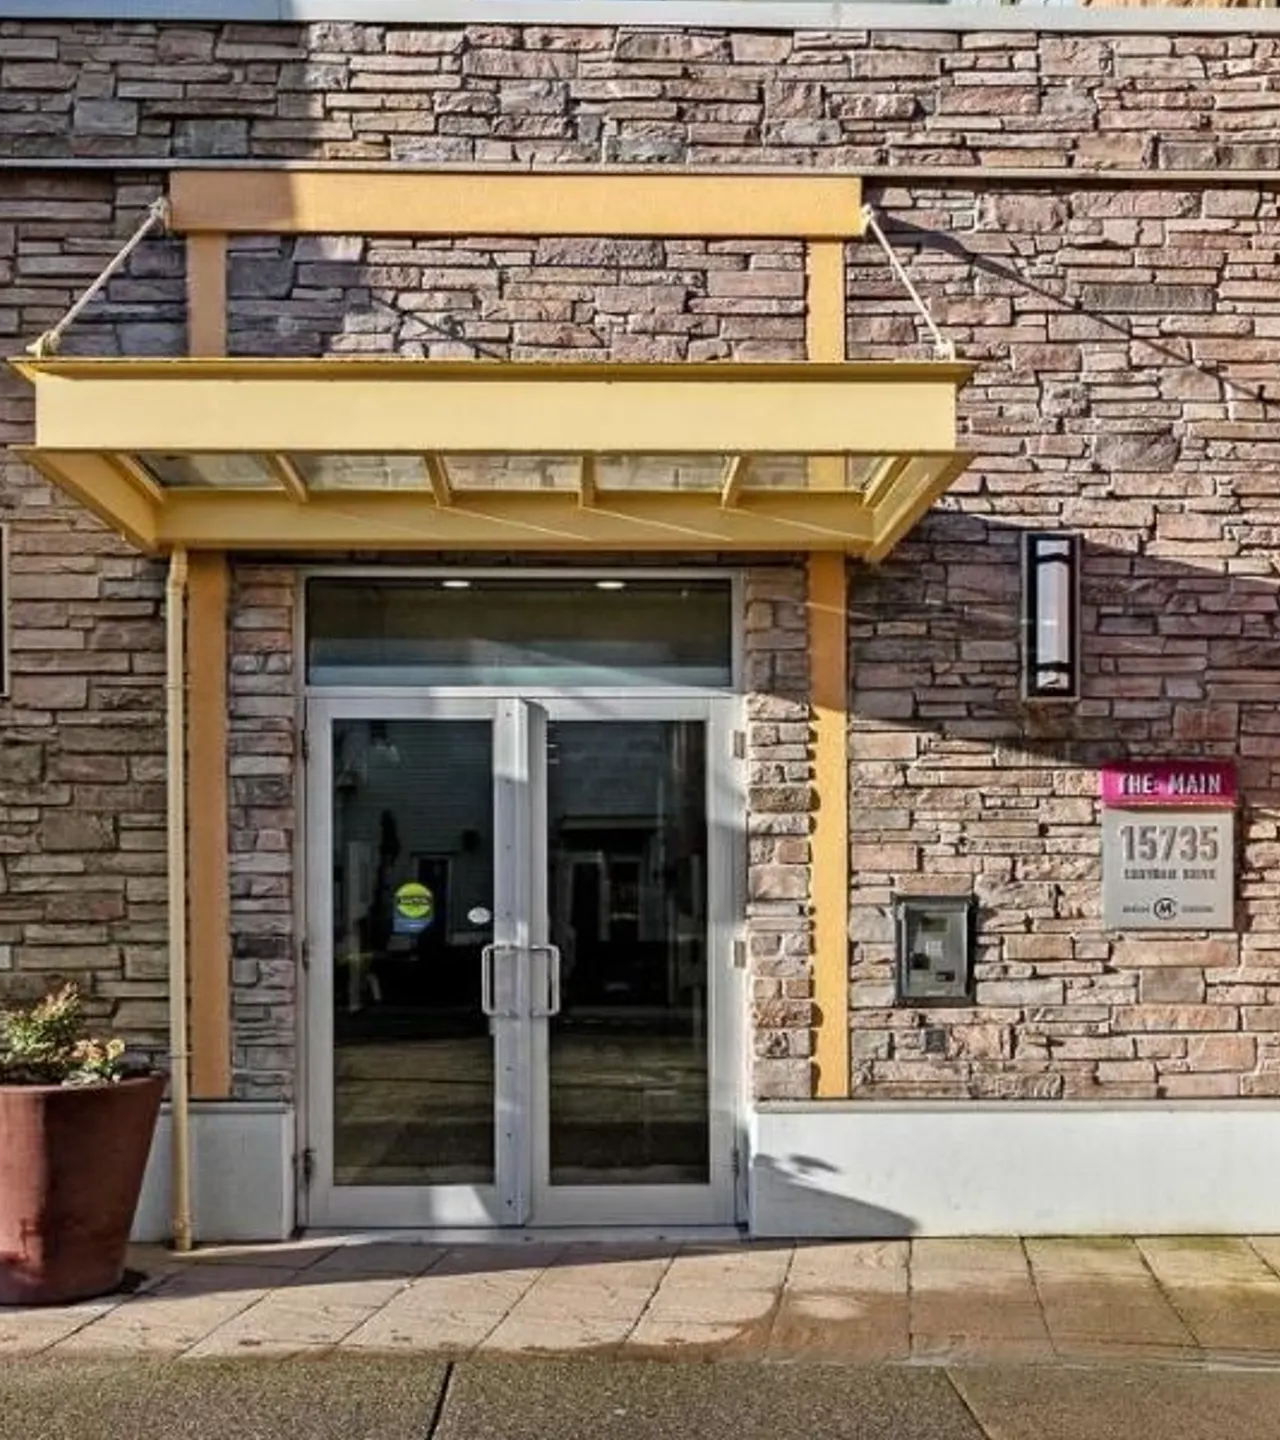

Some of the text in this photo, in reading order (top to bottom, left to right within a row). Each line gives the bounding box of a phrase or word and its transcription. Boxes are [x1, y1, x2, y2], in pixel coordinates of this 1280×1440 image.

[1118, 772, 1221, 794] THE MAIN
[1120, 825, 1219, 862] 15735
